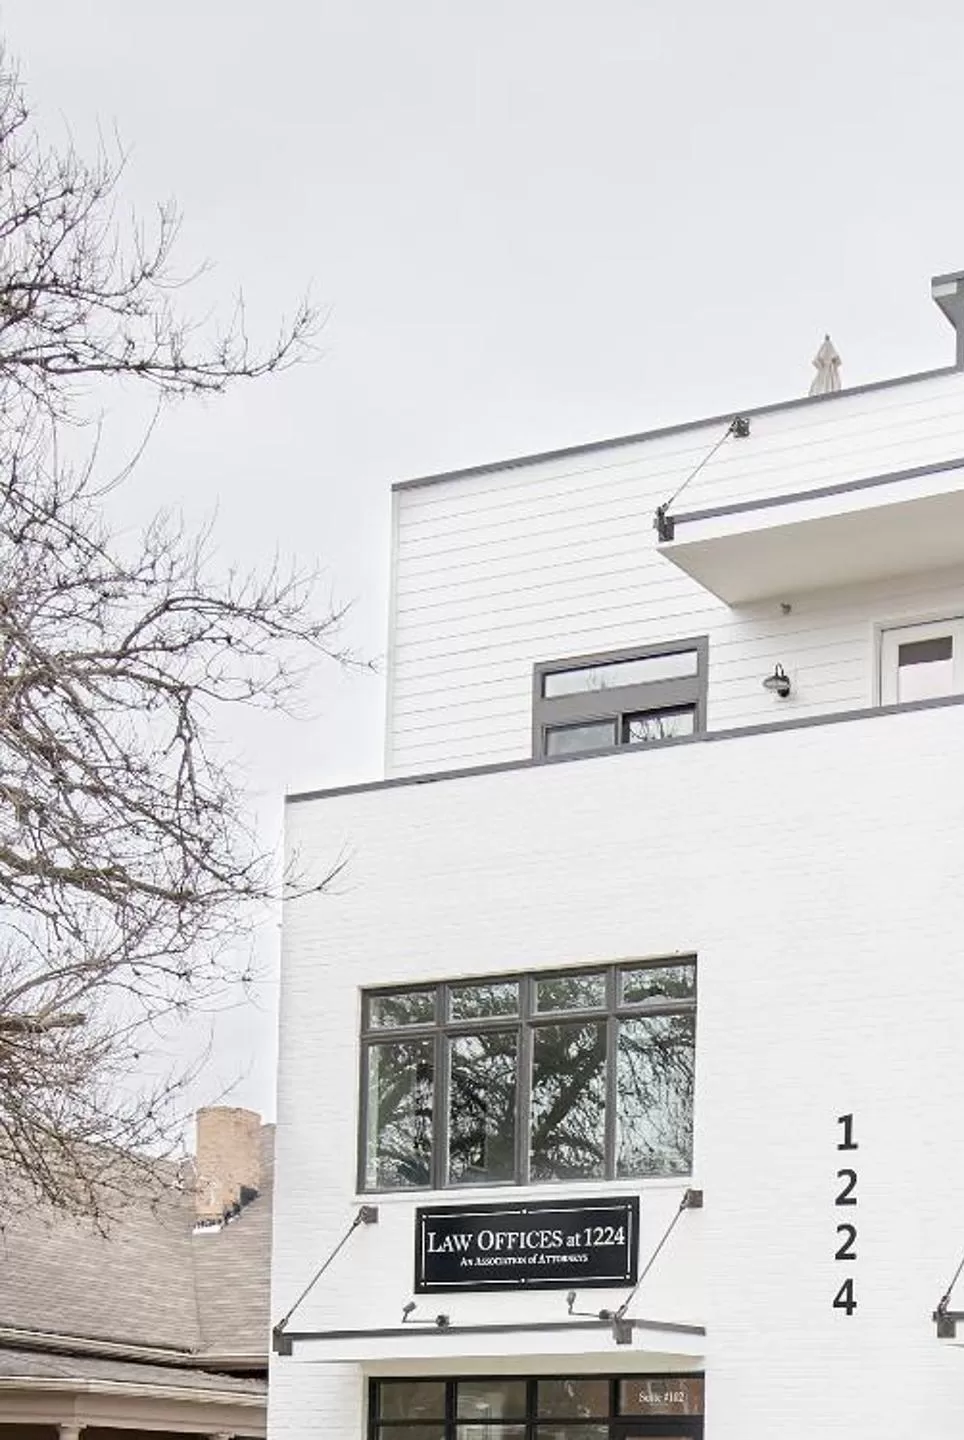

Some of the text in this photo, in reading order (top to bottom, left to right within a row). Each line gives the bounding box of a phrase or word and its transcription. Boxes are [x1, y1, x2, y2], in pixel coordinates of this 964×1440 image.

[427, 1226, 626, 1253] LAW OFFICES at 1224
